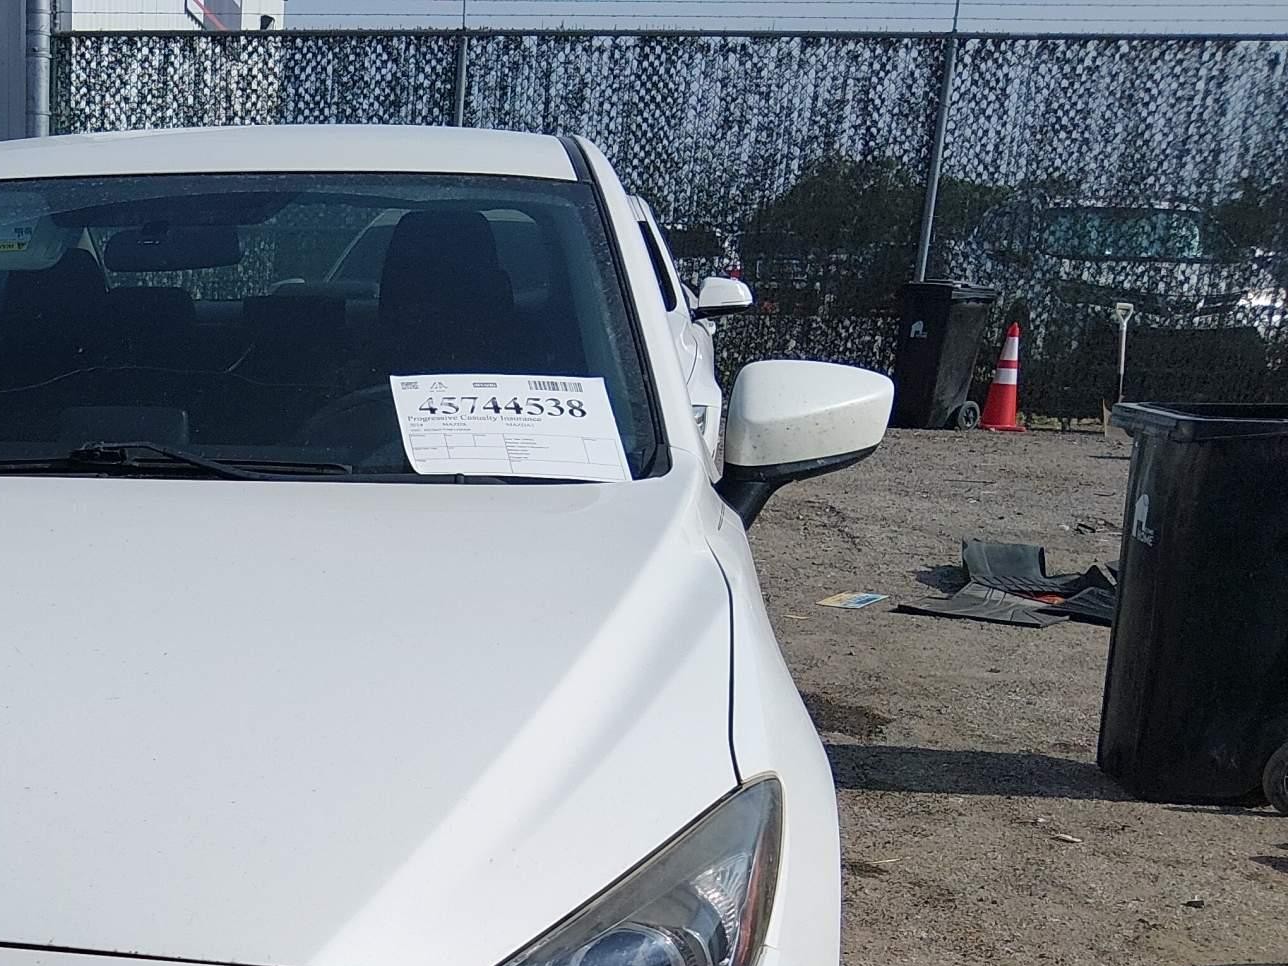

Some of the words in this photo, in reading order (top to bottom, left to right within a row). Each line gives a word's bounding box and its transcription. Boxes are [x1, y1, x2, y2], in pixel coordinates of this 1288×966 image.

[418, 396, 587, 418] 45744538
[407, 415, 459, 423] Progressive
[460, 414, 498, 423] Casualty
[500, 415, 542, 423] Insurance
